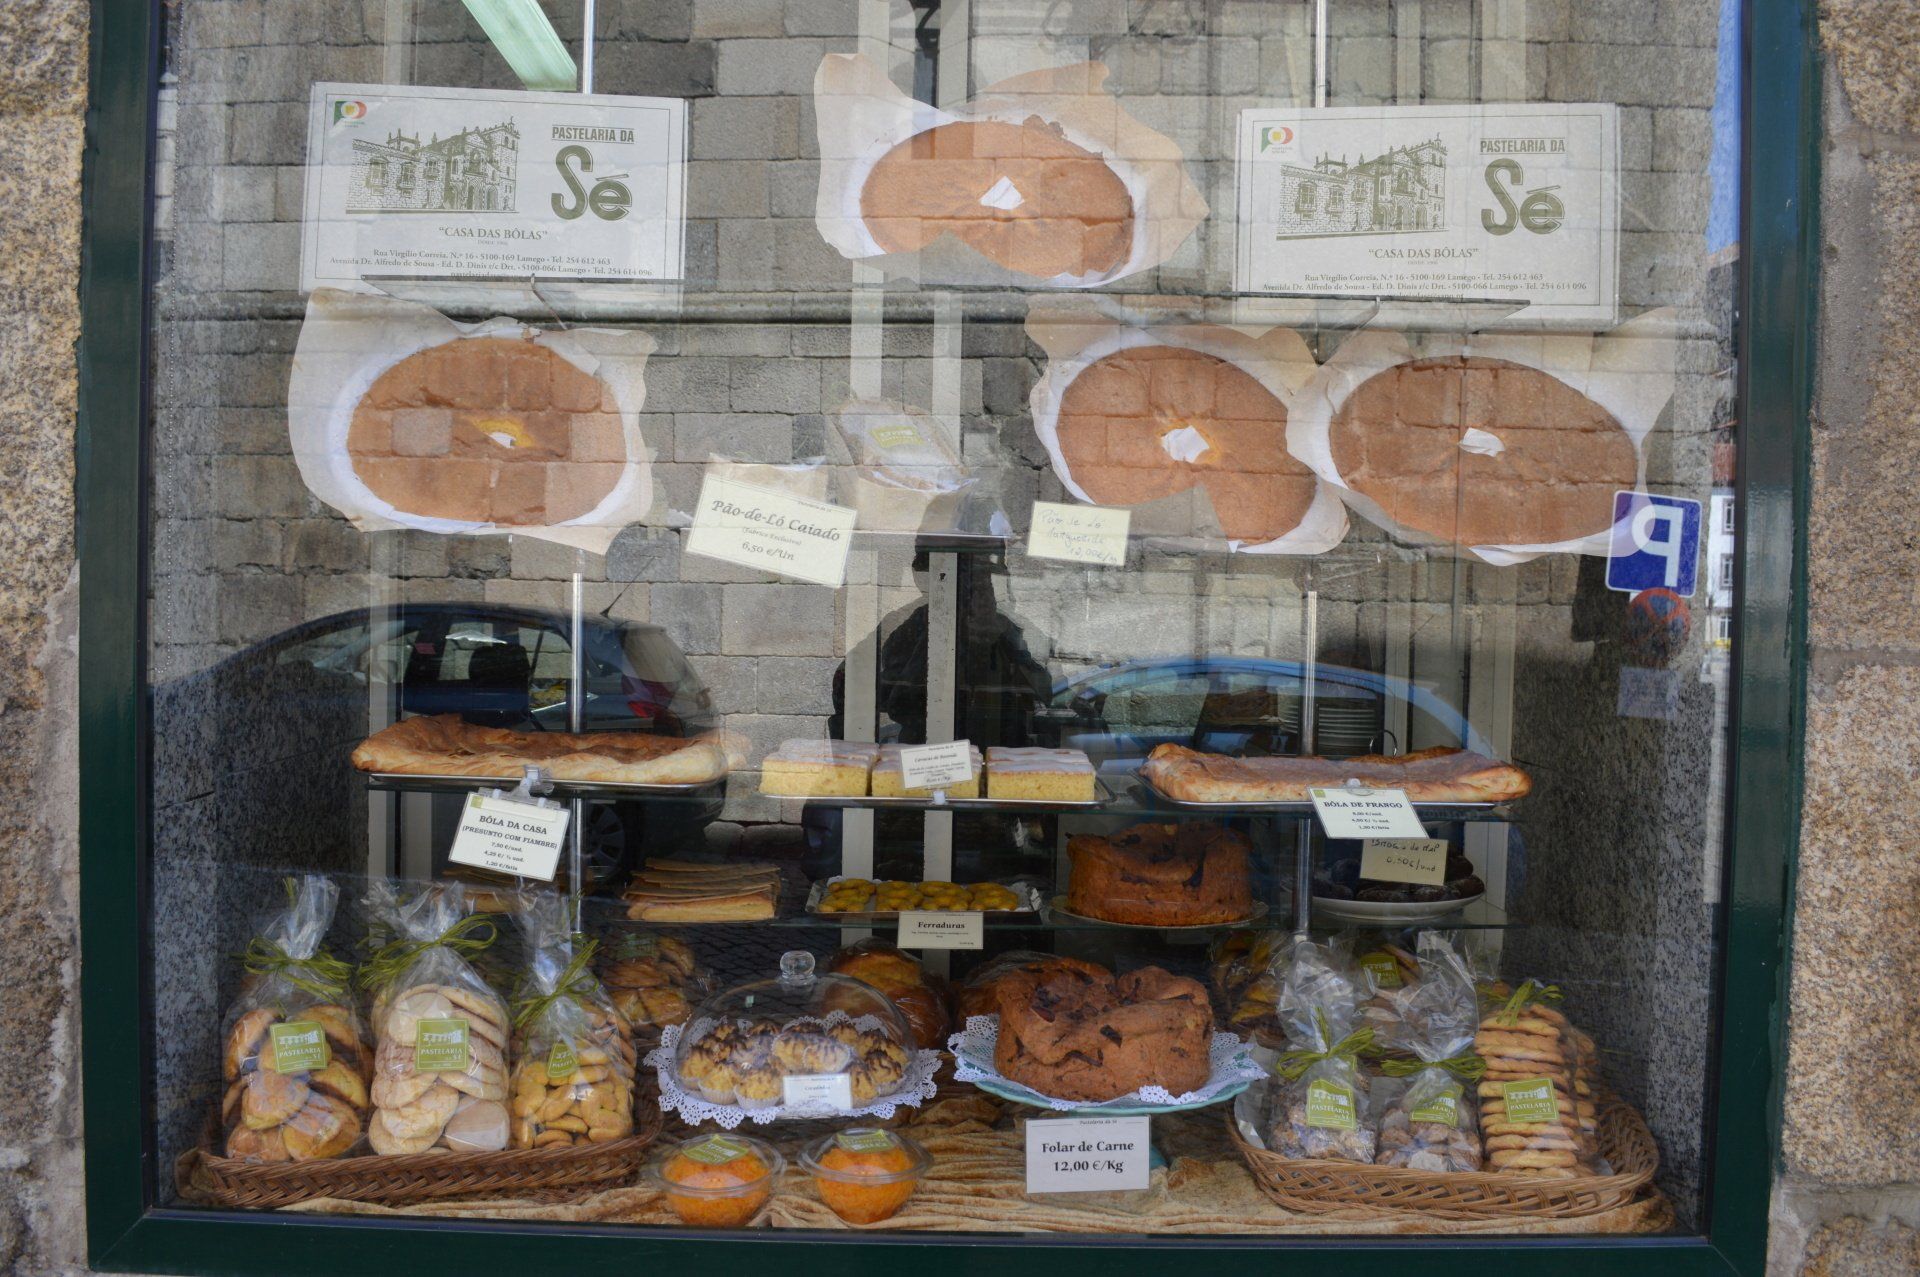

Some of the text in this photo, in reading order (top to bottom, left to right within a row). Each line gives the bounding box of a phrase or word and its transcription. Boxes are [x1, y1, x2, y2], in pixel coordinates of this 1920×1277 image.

[552, 126, 634, 142] PASTELARIA DA
[1480, 139, 1565, 152] PASTELARIA DA
[551, 145, 632, 221] Sé
[1481, 158, 1565, 236] Sé
[478, 228, 500, 238] DAS
[374, 248, 388, 256] Rua
[480, 253, 514, 261] 5100-169
[517, 255, 545, 264] Lamego
[566, 256, 580, 264] 254
[1408, 249, 1431, 258] DAS
[330, 257, 358, 265] Avenida
[375, 258, 400, 266] Alfredo
[489, 262, 499, 270] r/c
[522, 264, 556, 272] 5100-066
[558, 266, 586, 274] Lamego
[608, 267, 621, 275] 254
[1447, 274, 1476, 282] Lamego
[1452, 282, 1487, 290] 5100-066
[1489, 283, 1518, 291] Lamego
[712, 500, 785, 527] Pão-de-Ló
[788, 518, 840, 542] Caiado
[742, 542, 763, 552] 6,50
[507, 821, 520, 830] DA
[523, 824, 547, 834] CASA
[462, 826, 558, 850] (PRESUNTO COM FIAMBRE)
[279, 1047, 321, 1058] PASTELARIA
[1311, 1104, 1350, 1115] PASTELARIA
[1510, 1102, 1551, 1110] PASTELARIA
[1042, 1141, 1134, 1153] Folar de Carne
[1055, 1160, 1124, 1173] 12,00 €/Kg
